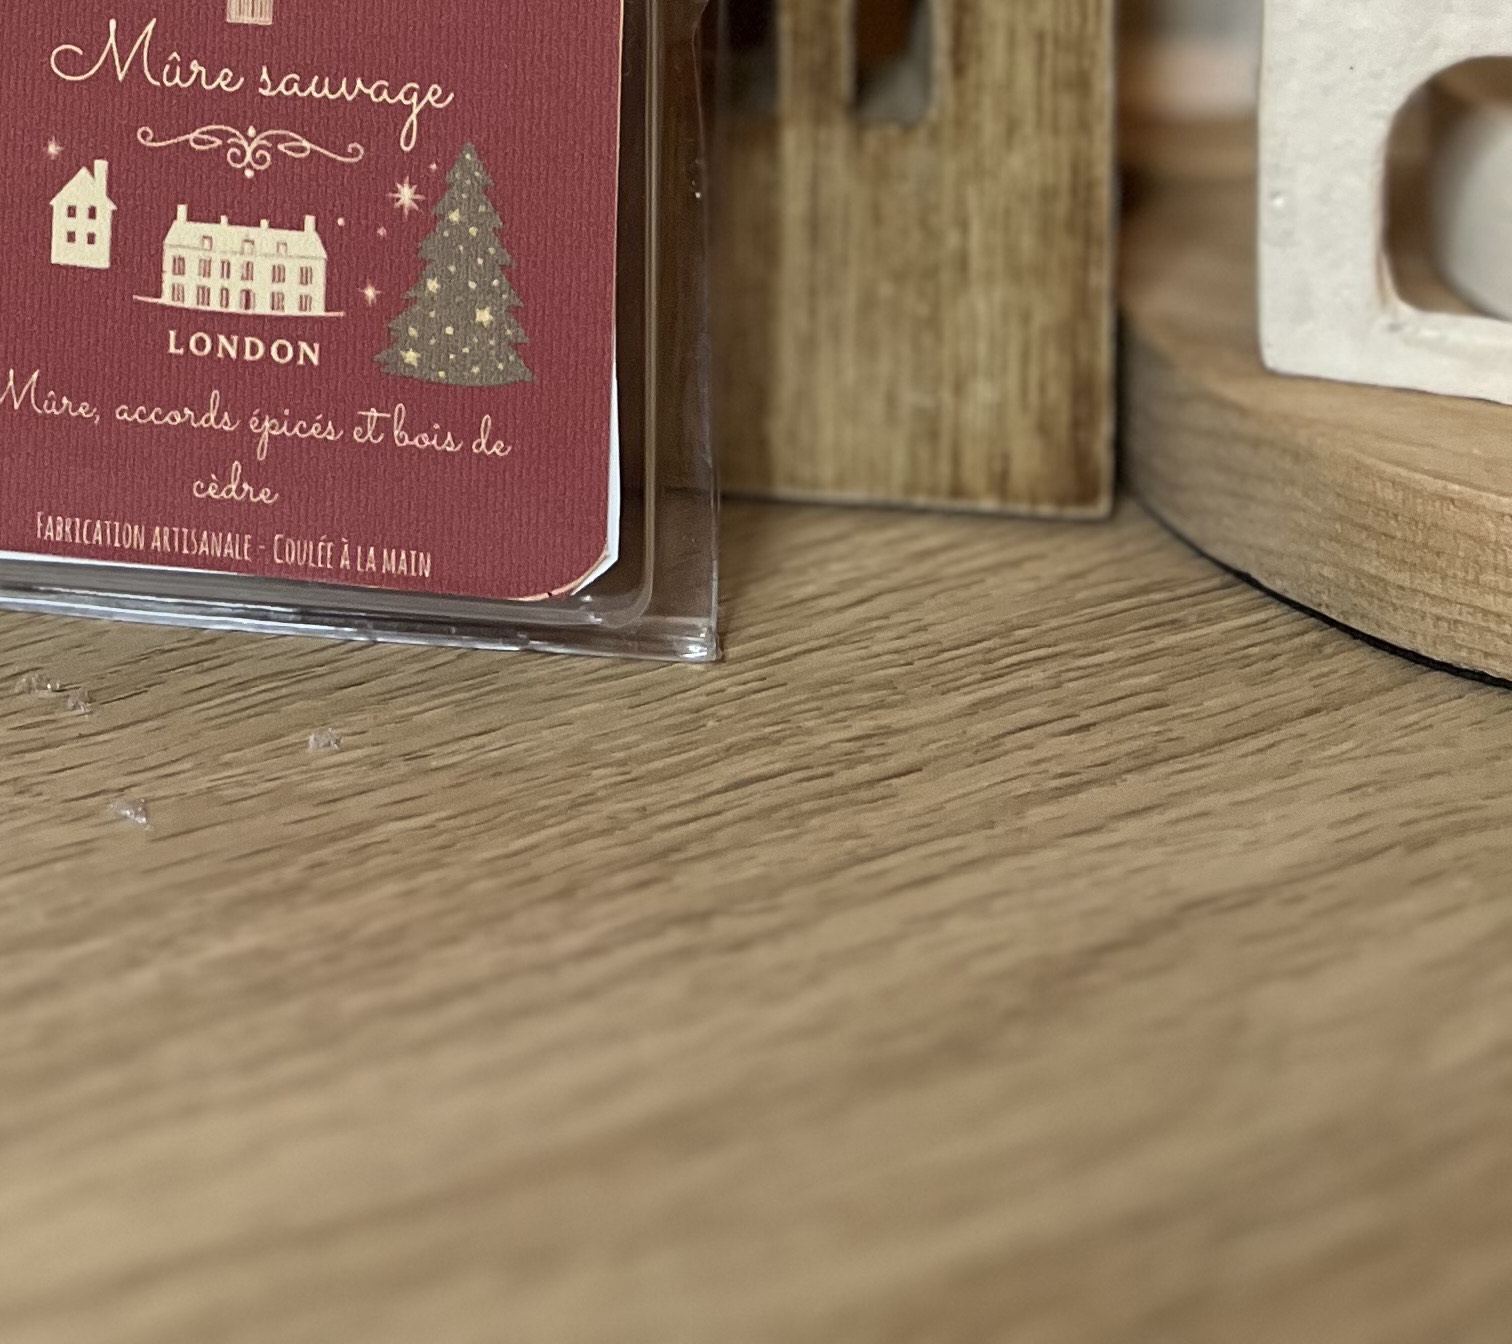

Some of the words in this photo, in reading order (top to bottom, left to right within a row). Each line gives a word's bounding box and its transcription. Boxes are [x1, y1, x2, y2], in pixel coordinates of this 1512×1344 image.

[50, 15, 247, 93] Mûre
[257, 65, 455, 154] sauvage
[167, 329, 320, 366] LONDON
[115, 389, 242, 432] accords
[249, 408, 344, 461] épicés
[352, 407, 392, 444] et
[393, 403, 464, 452] bois
[471, 414, 512, 457] de
[192, 460, 279, 504] cèdre
[36, 511, 145, 551] FABRICATION
[150, 525, 252, 562] ARTISANALE
[273, 533, 334, 569] COULÉE
[339, 537, 351, 570] À
[356, 545, 377, 572] LA
[381, 547, 432, 578] MAIN
